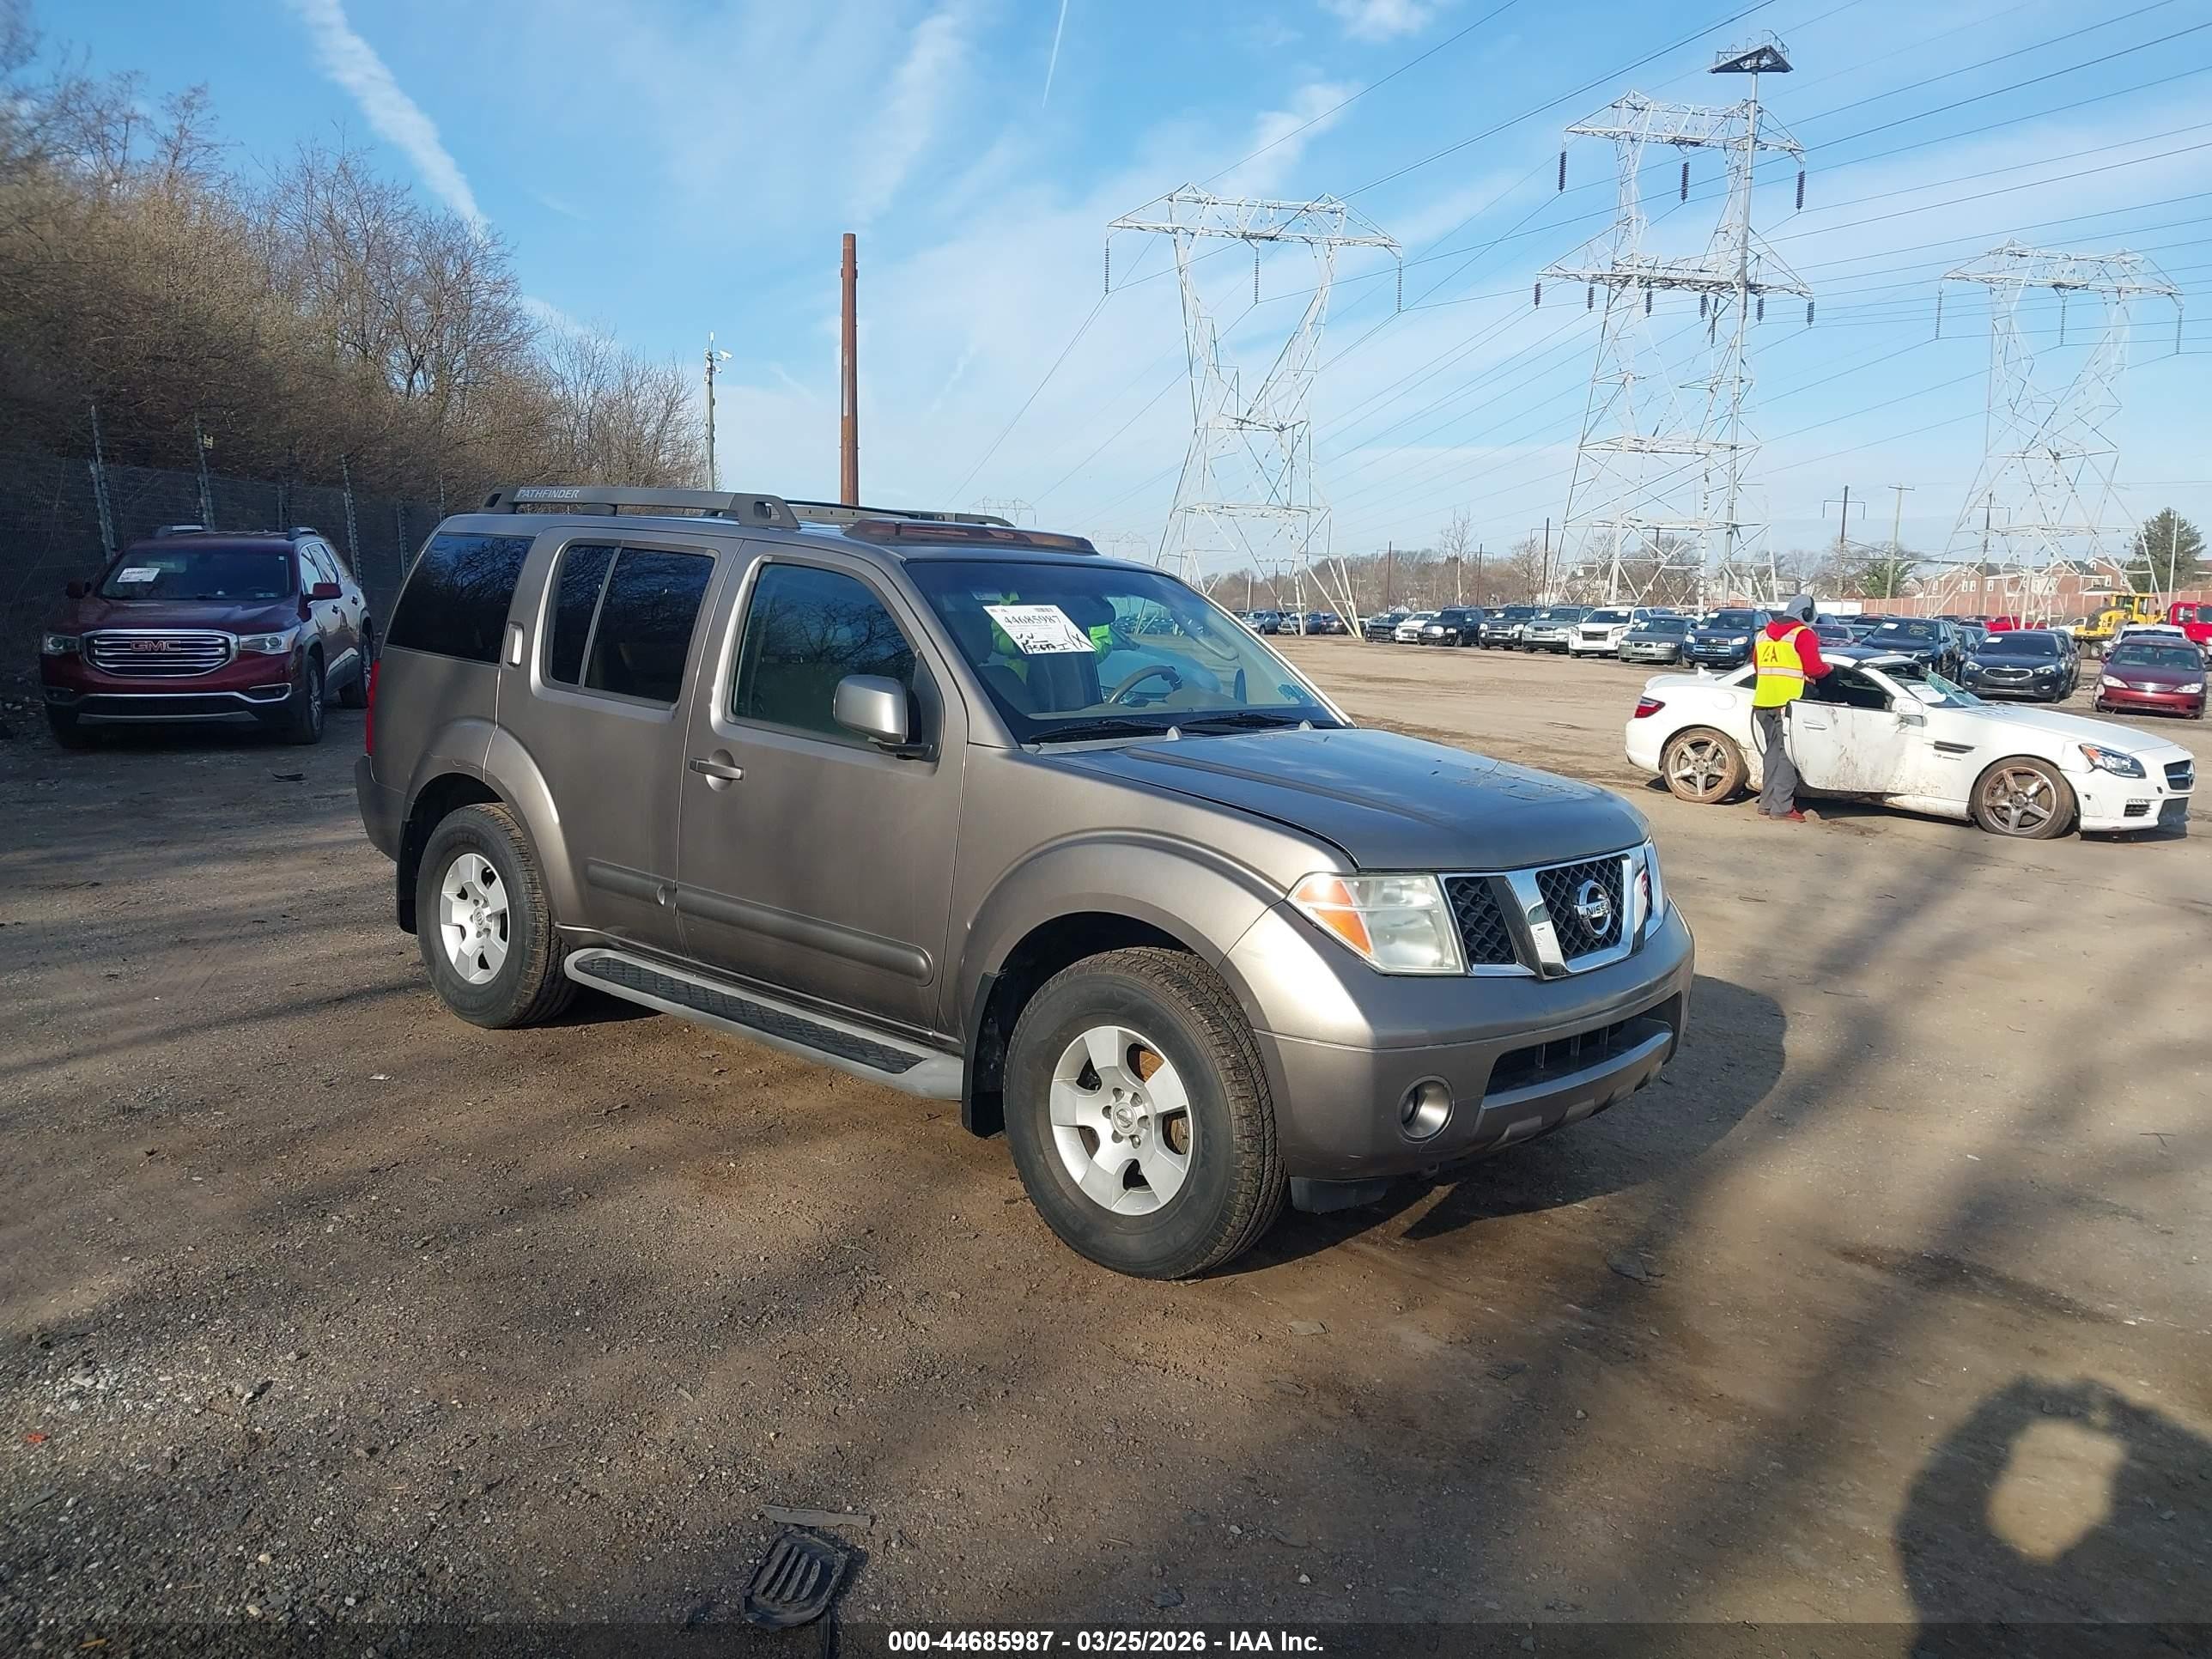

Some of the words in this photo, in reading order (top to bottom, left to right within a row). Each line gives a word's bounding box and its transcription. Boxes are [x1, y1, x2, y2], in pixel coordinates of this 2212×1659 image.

[517, 489, 580, 499] PATHFINDER
[1004, 615, 1062, 625] 44685987
[130, 640, 182, 652] GMC
[1585, 902, 1609, 916] NISS
